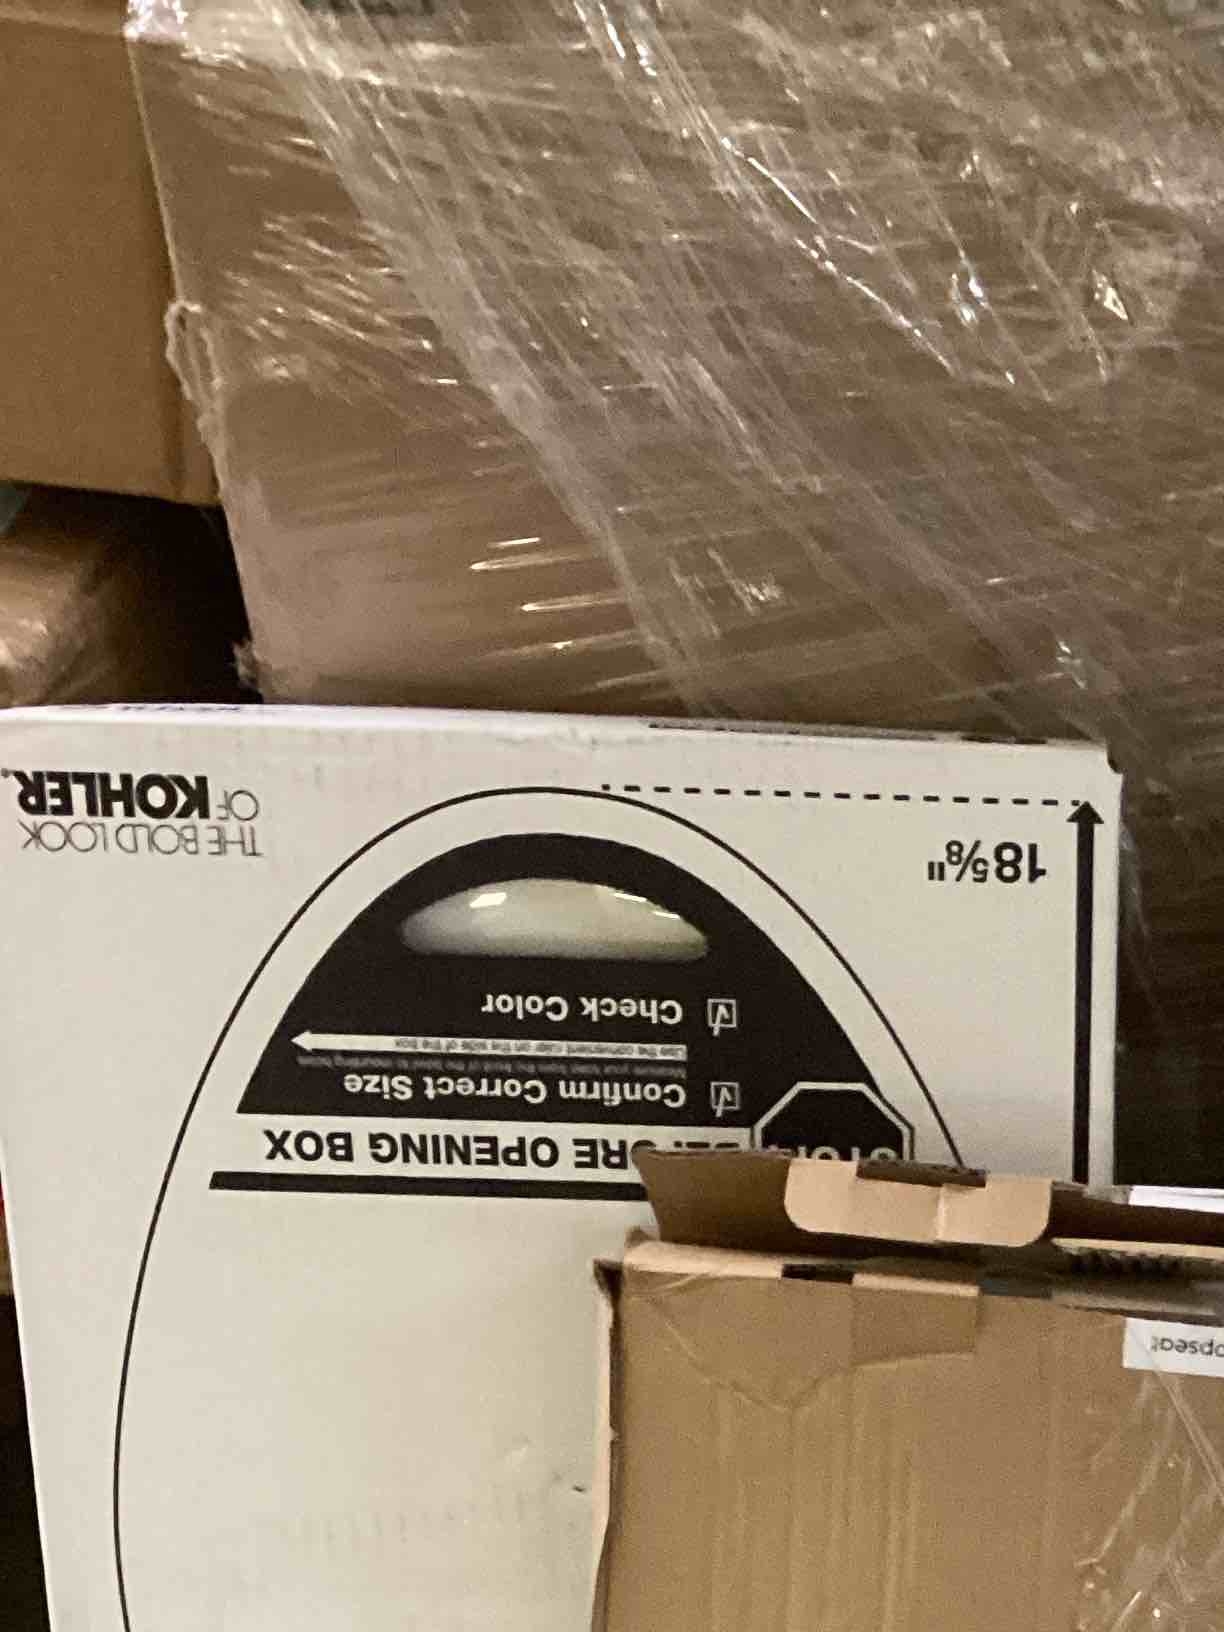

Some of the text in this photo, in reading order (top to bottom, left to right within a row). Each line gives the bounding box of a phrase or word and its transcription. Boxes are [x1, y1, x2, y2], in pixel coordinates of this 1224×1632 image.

[216, 789, 259, 821] OF
[17, 819, 264, 857] THE BOLD LOOK
[480, 993, 684, 1025] Check Color
[343, 1073, 687, 1109] Confirm Correct Size
[262, 1129, 354, 1163] BOX
[367, 1131, 561, 1169] OPENING
